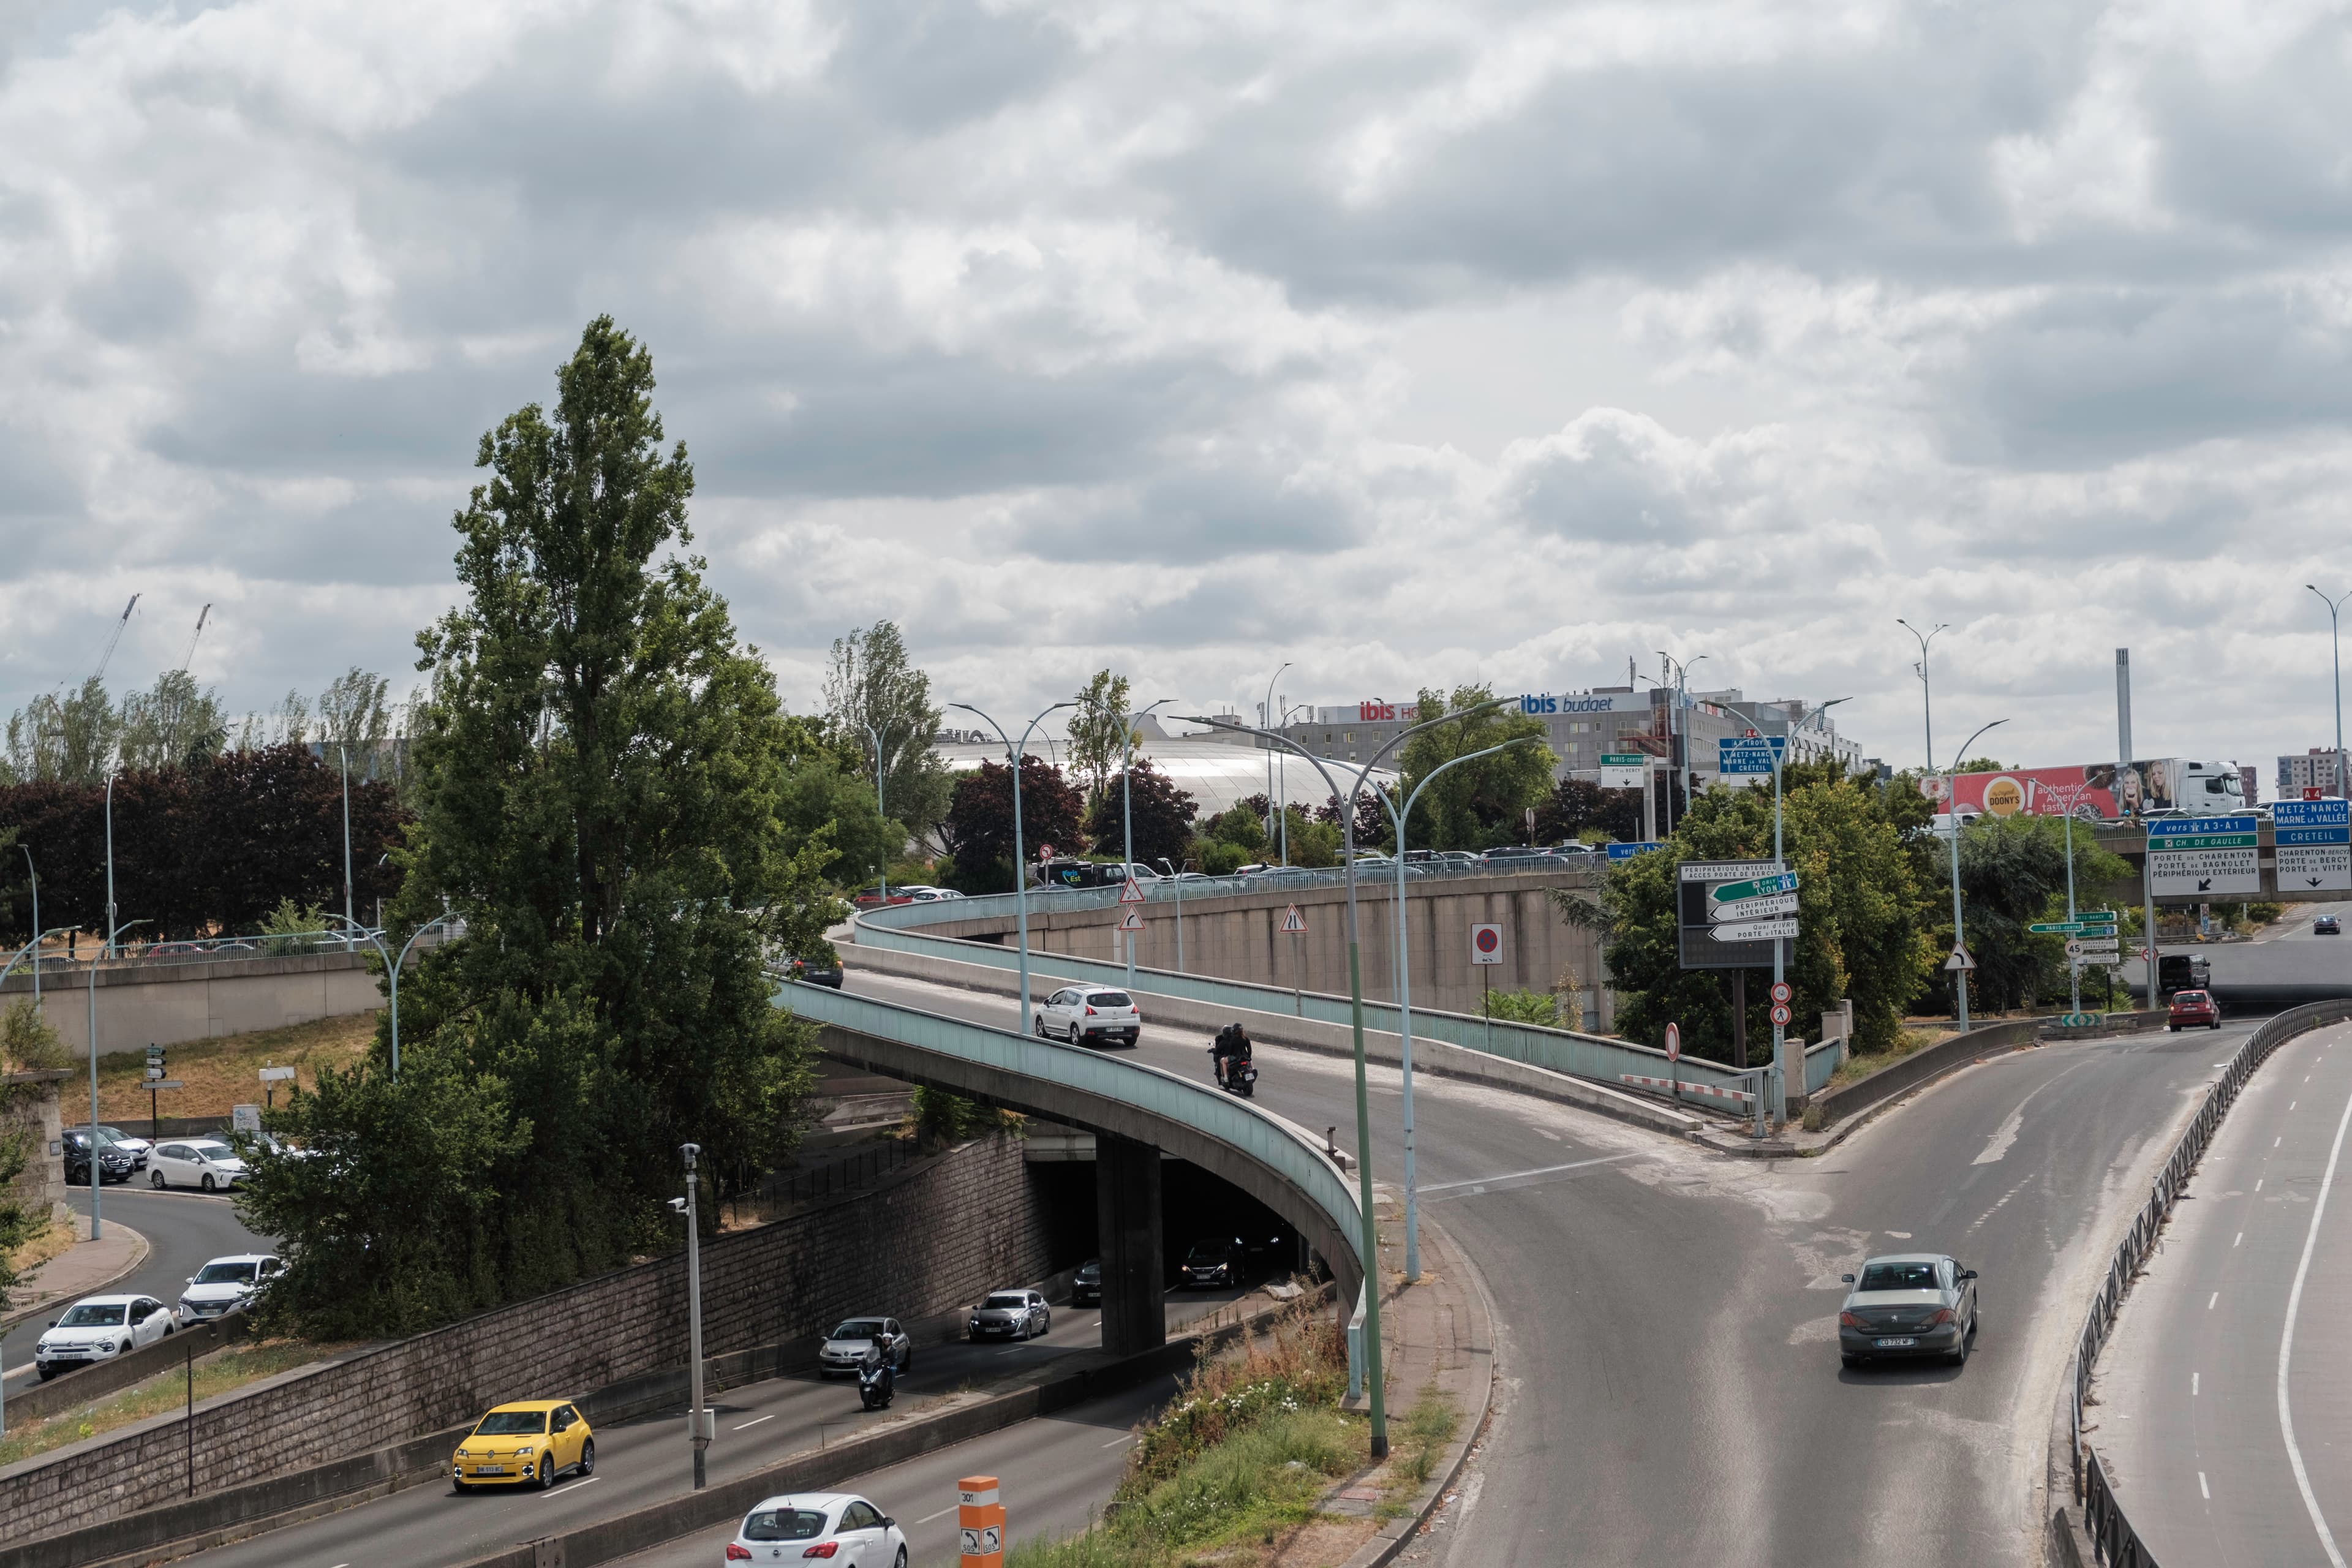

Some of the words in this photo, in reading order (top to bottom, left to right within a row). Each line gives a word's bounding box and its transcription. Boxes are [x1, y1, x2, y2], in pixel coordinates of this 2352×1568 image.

[1521, 693, 1556, 714] ibis
[1563, 696, 1613, 712] budget
[1360, 701, 1395, 720] ibis
[2038, 784, 2083, 794] authentic
[1990, 796, 2019, 805] DOONY'S
[2046, 791, 2092, 802] American
[2276, 815, 2306, 824] MARNE
[2316, 812, 2348, 823] VALLÉE
[2153, 868, 2211, 878] PÉRIPHÉRIQUE
[2213, 867, 2256, 876] EXTÉRIEUR
[1757, 885, 1777, 895] LYON
[1735, 896, 1795, 910] PÉRIPHÉRIQUE
[1736, 906, 1779, 917] INTÉRIEUR
[2069, 944, 2081, 953] 45
[962, 1493, 973, 1502] 301
[985, 1543, 995, 1551] SOS
